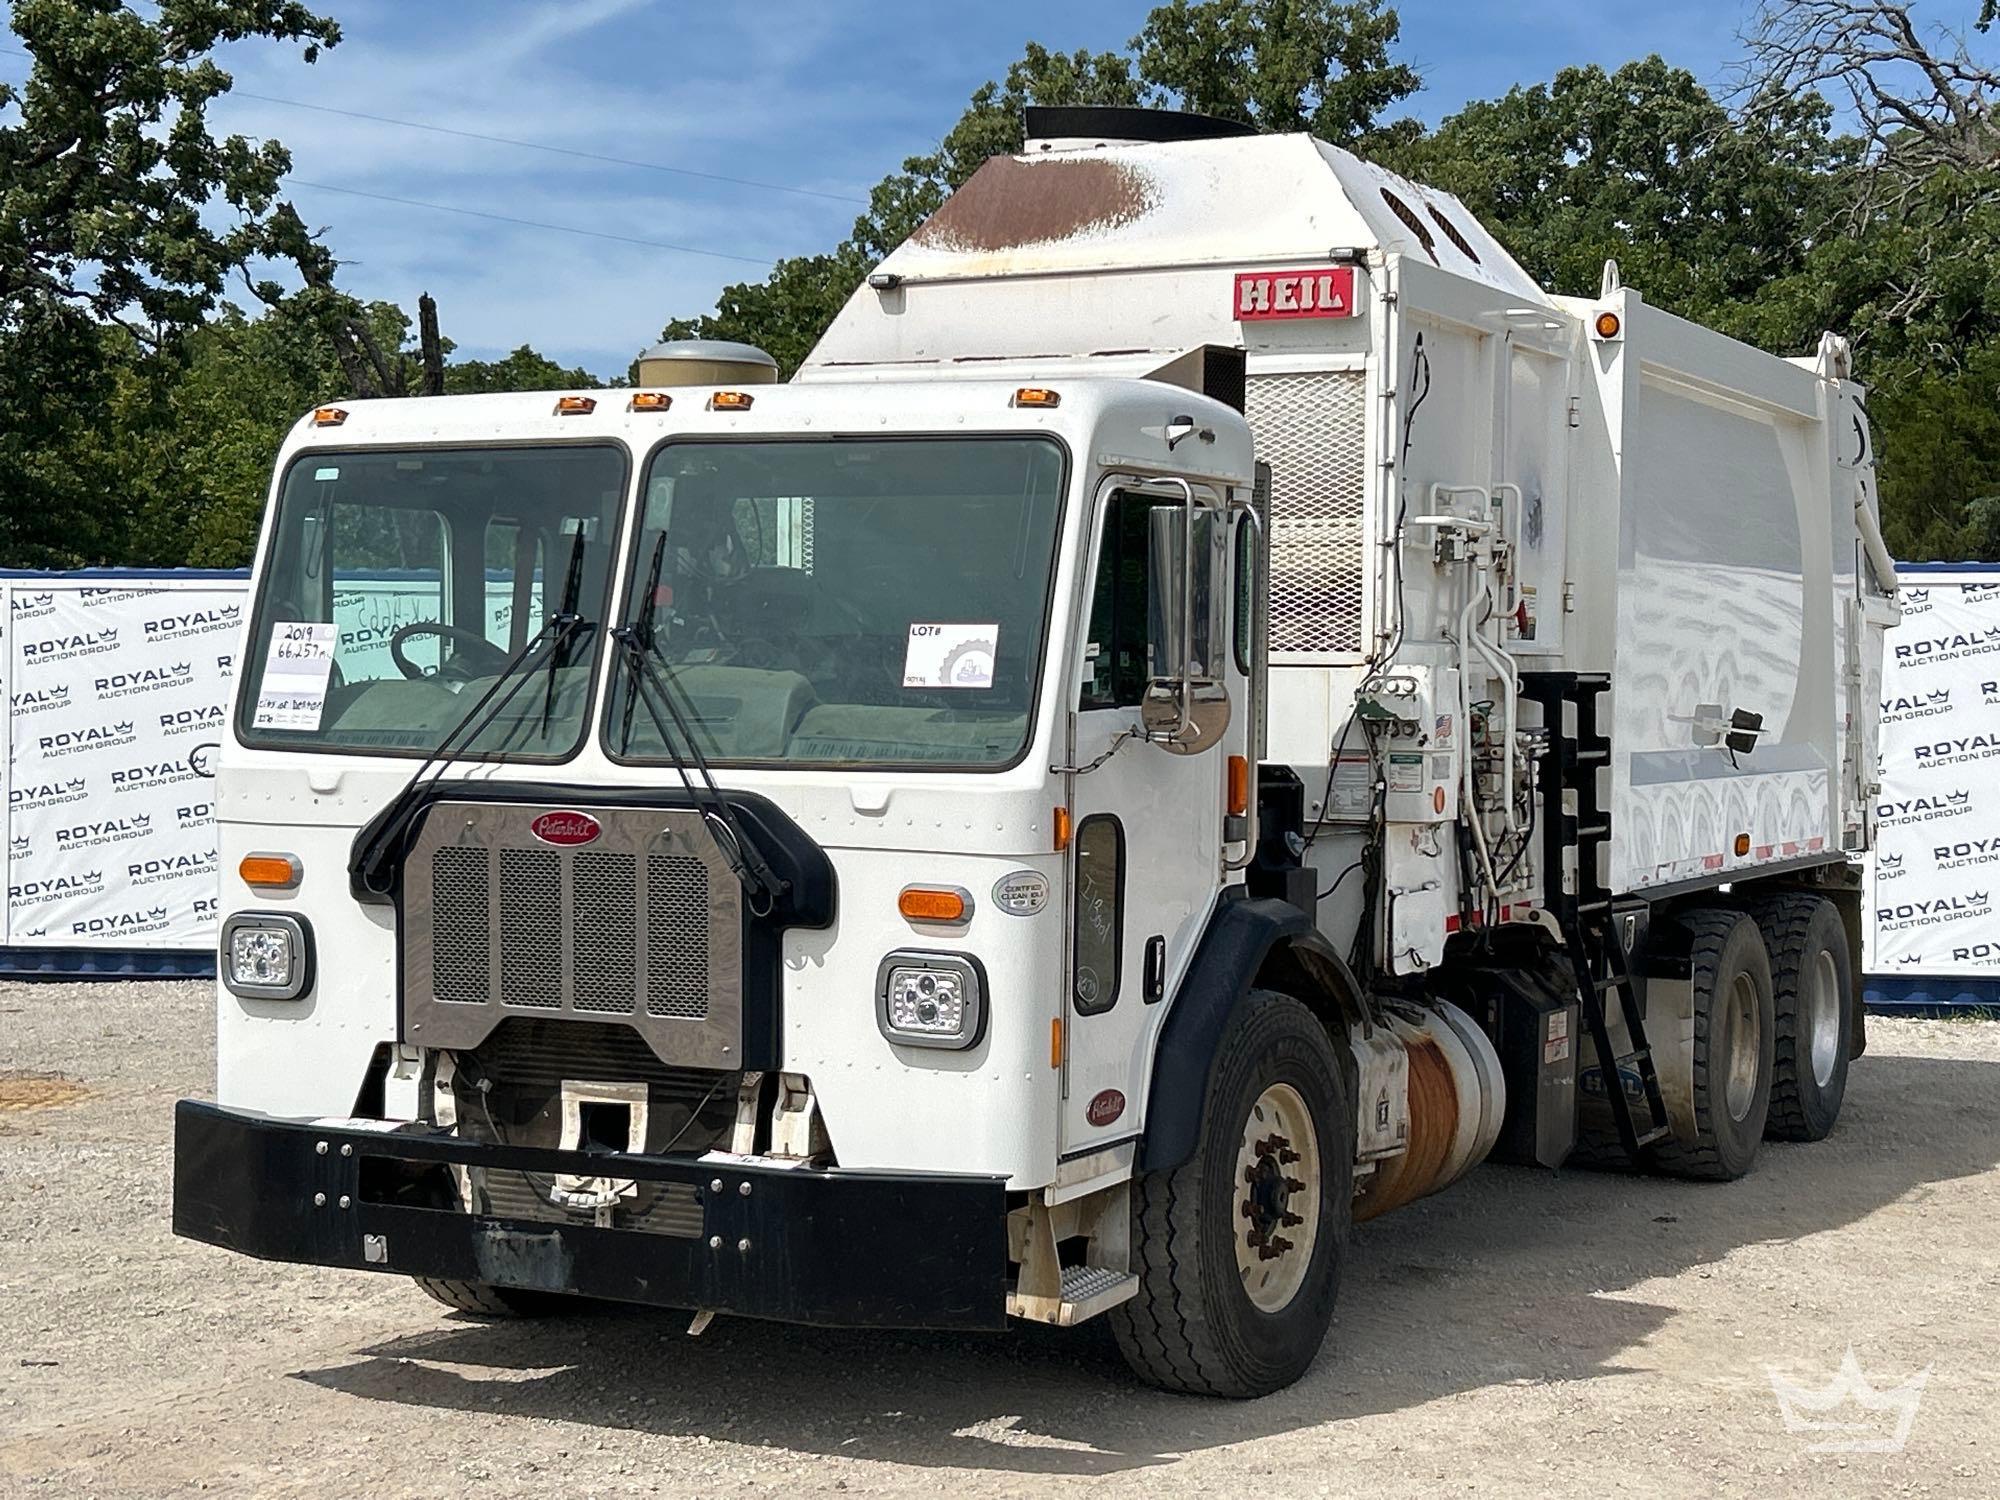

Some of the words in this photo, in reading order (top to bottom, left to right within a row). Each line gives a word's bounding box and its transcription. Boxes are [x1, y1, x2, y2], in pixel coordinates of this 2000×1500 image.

[1239, 275, 1344, 312] HEIL
[82, 592, 135, 608] AUCTION
[15, 606, 57, 620] GROUP
[143, 610, 221, 634] ROYAL
[146, 627, 200, 643] AUCTION
[201, 619, 243, 634] GROUP
[911, 626, 942, 637] LOT#
[23, 633, 99, 657] ROYAL
[26, 650, 77, 666] AUCTION
[79, 642, 121, 657] GROUP
[1895, 632, 1984, 659] ROYAL
[1899, 651, 1960, 669] AUCTION
[94, 667, 171, 691] ROYAL
[97, 685, 150, 701] AUCTION
[152, 676, 194, 691] GROUP
[31, 699, 72, 713] GROUP
[1904, 704, 1953, 720] GROUP
[39, 726, 114, 750] ROYAL
[163, 721, 216, 737] AUCTION
[42, 743, 94, 759] AUCTION
[95, 735, 136, 750] GROUP
[111, 760, 188, 785] ROYAL
[1918, 752, 1979, 770] AUCTION
[114, 778, 167, 794] AUCTION
[47, 792, 89, 806] GROUP
[1924, 805, 1973, 821] GROUP
[55, 818, 132, 842] ROYAL
[538, 816, 595, 837] Peterbilt
[58, 836, 111, 852] AUCTION
[112, 828, 154, 842] GROUP
[127, 853, 204, 877] ROYAL
[1937, 853, 1999, 871] AUCTION
[8, 874, 84, 899] ROYAL
[130, 871, 184, 887] AUCTION
[10, 893, 63, 908] AUCTION
[64, 885, 105, 899] GROUP
[1877, 896, 1967, 923] ROYAL
[1880, 915, 1941, 933] AUCTION
[1943, 907, 1992, 922] GROUP
[72, 911, 148, 935] ROYAL
[128, 921, 170, 935] GROUP
